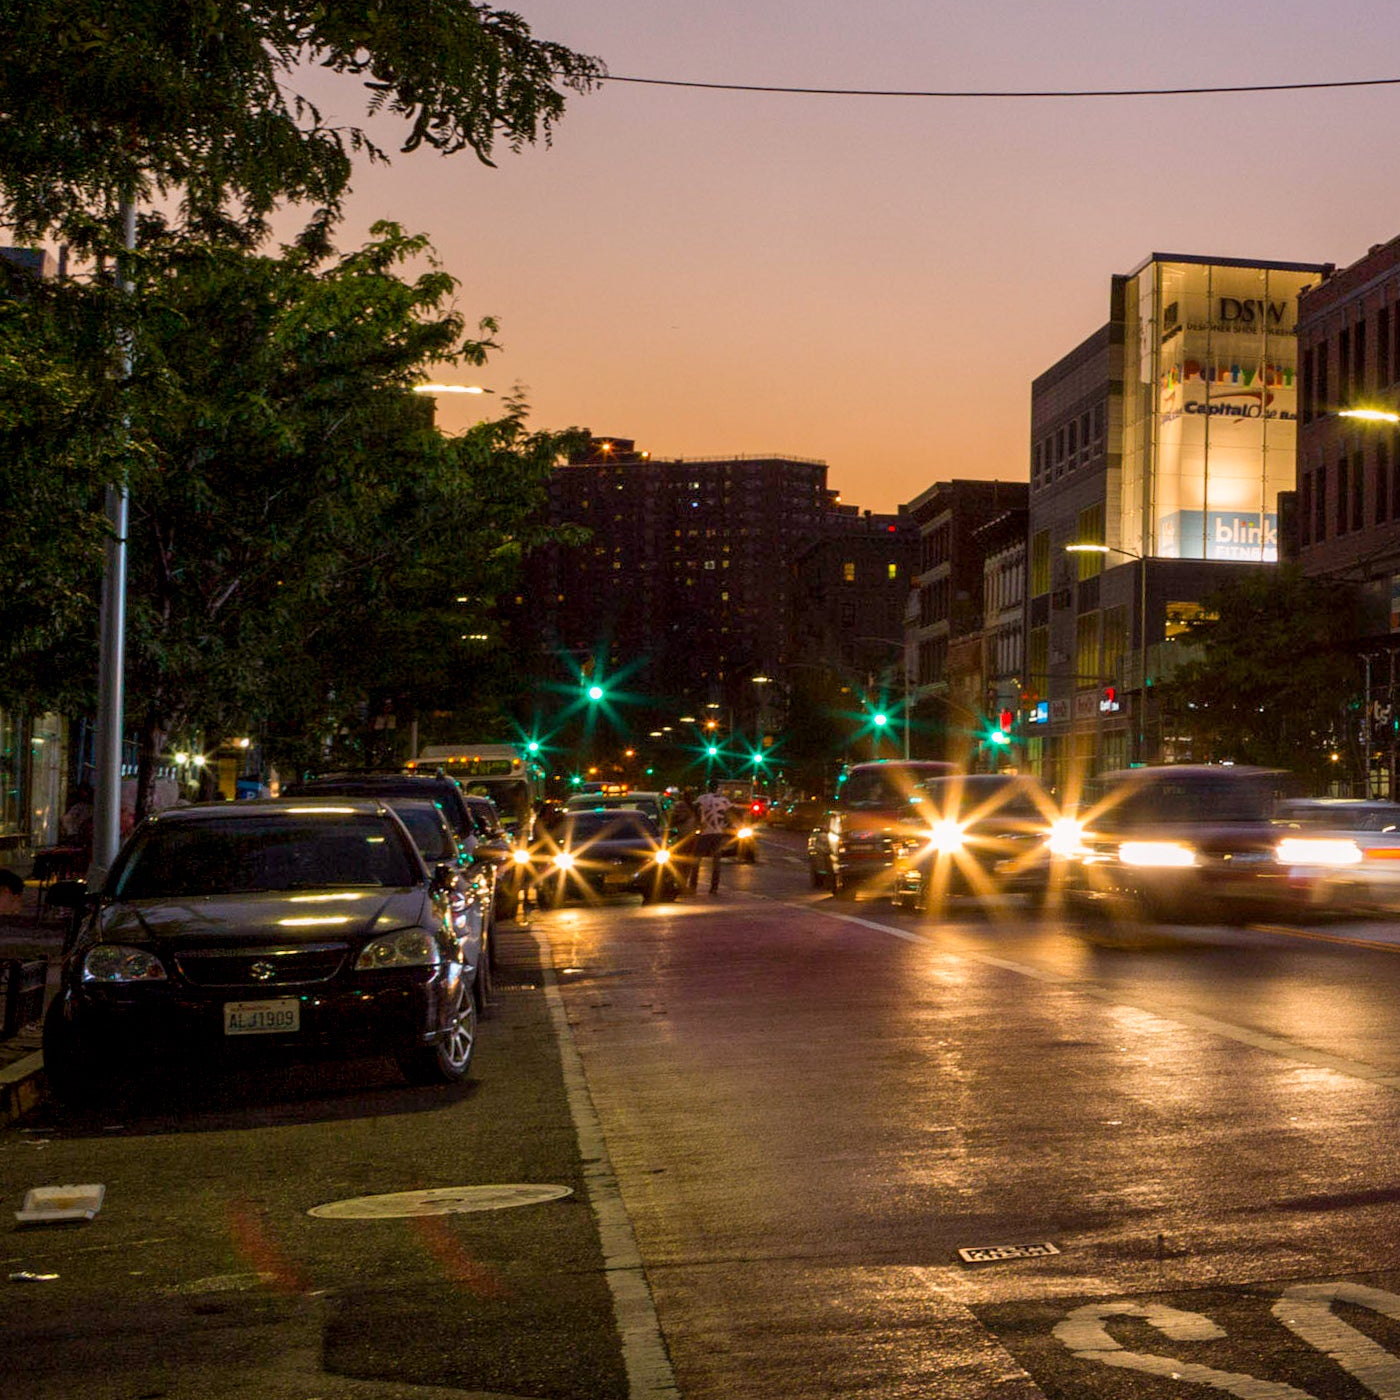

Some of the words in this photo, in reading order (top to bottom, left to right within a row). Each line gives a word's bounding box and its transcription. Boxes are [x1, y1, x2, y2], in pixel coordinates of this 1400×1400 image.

[1220, 297, 1286, 323] DSW
[1184, 400, 1248, 418] Capital
[1215, 517, 1277, 544] blink
[229, 1010, 294, 1029] ALJ1909
